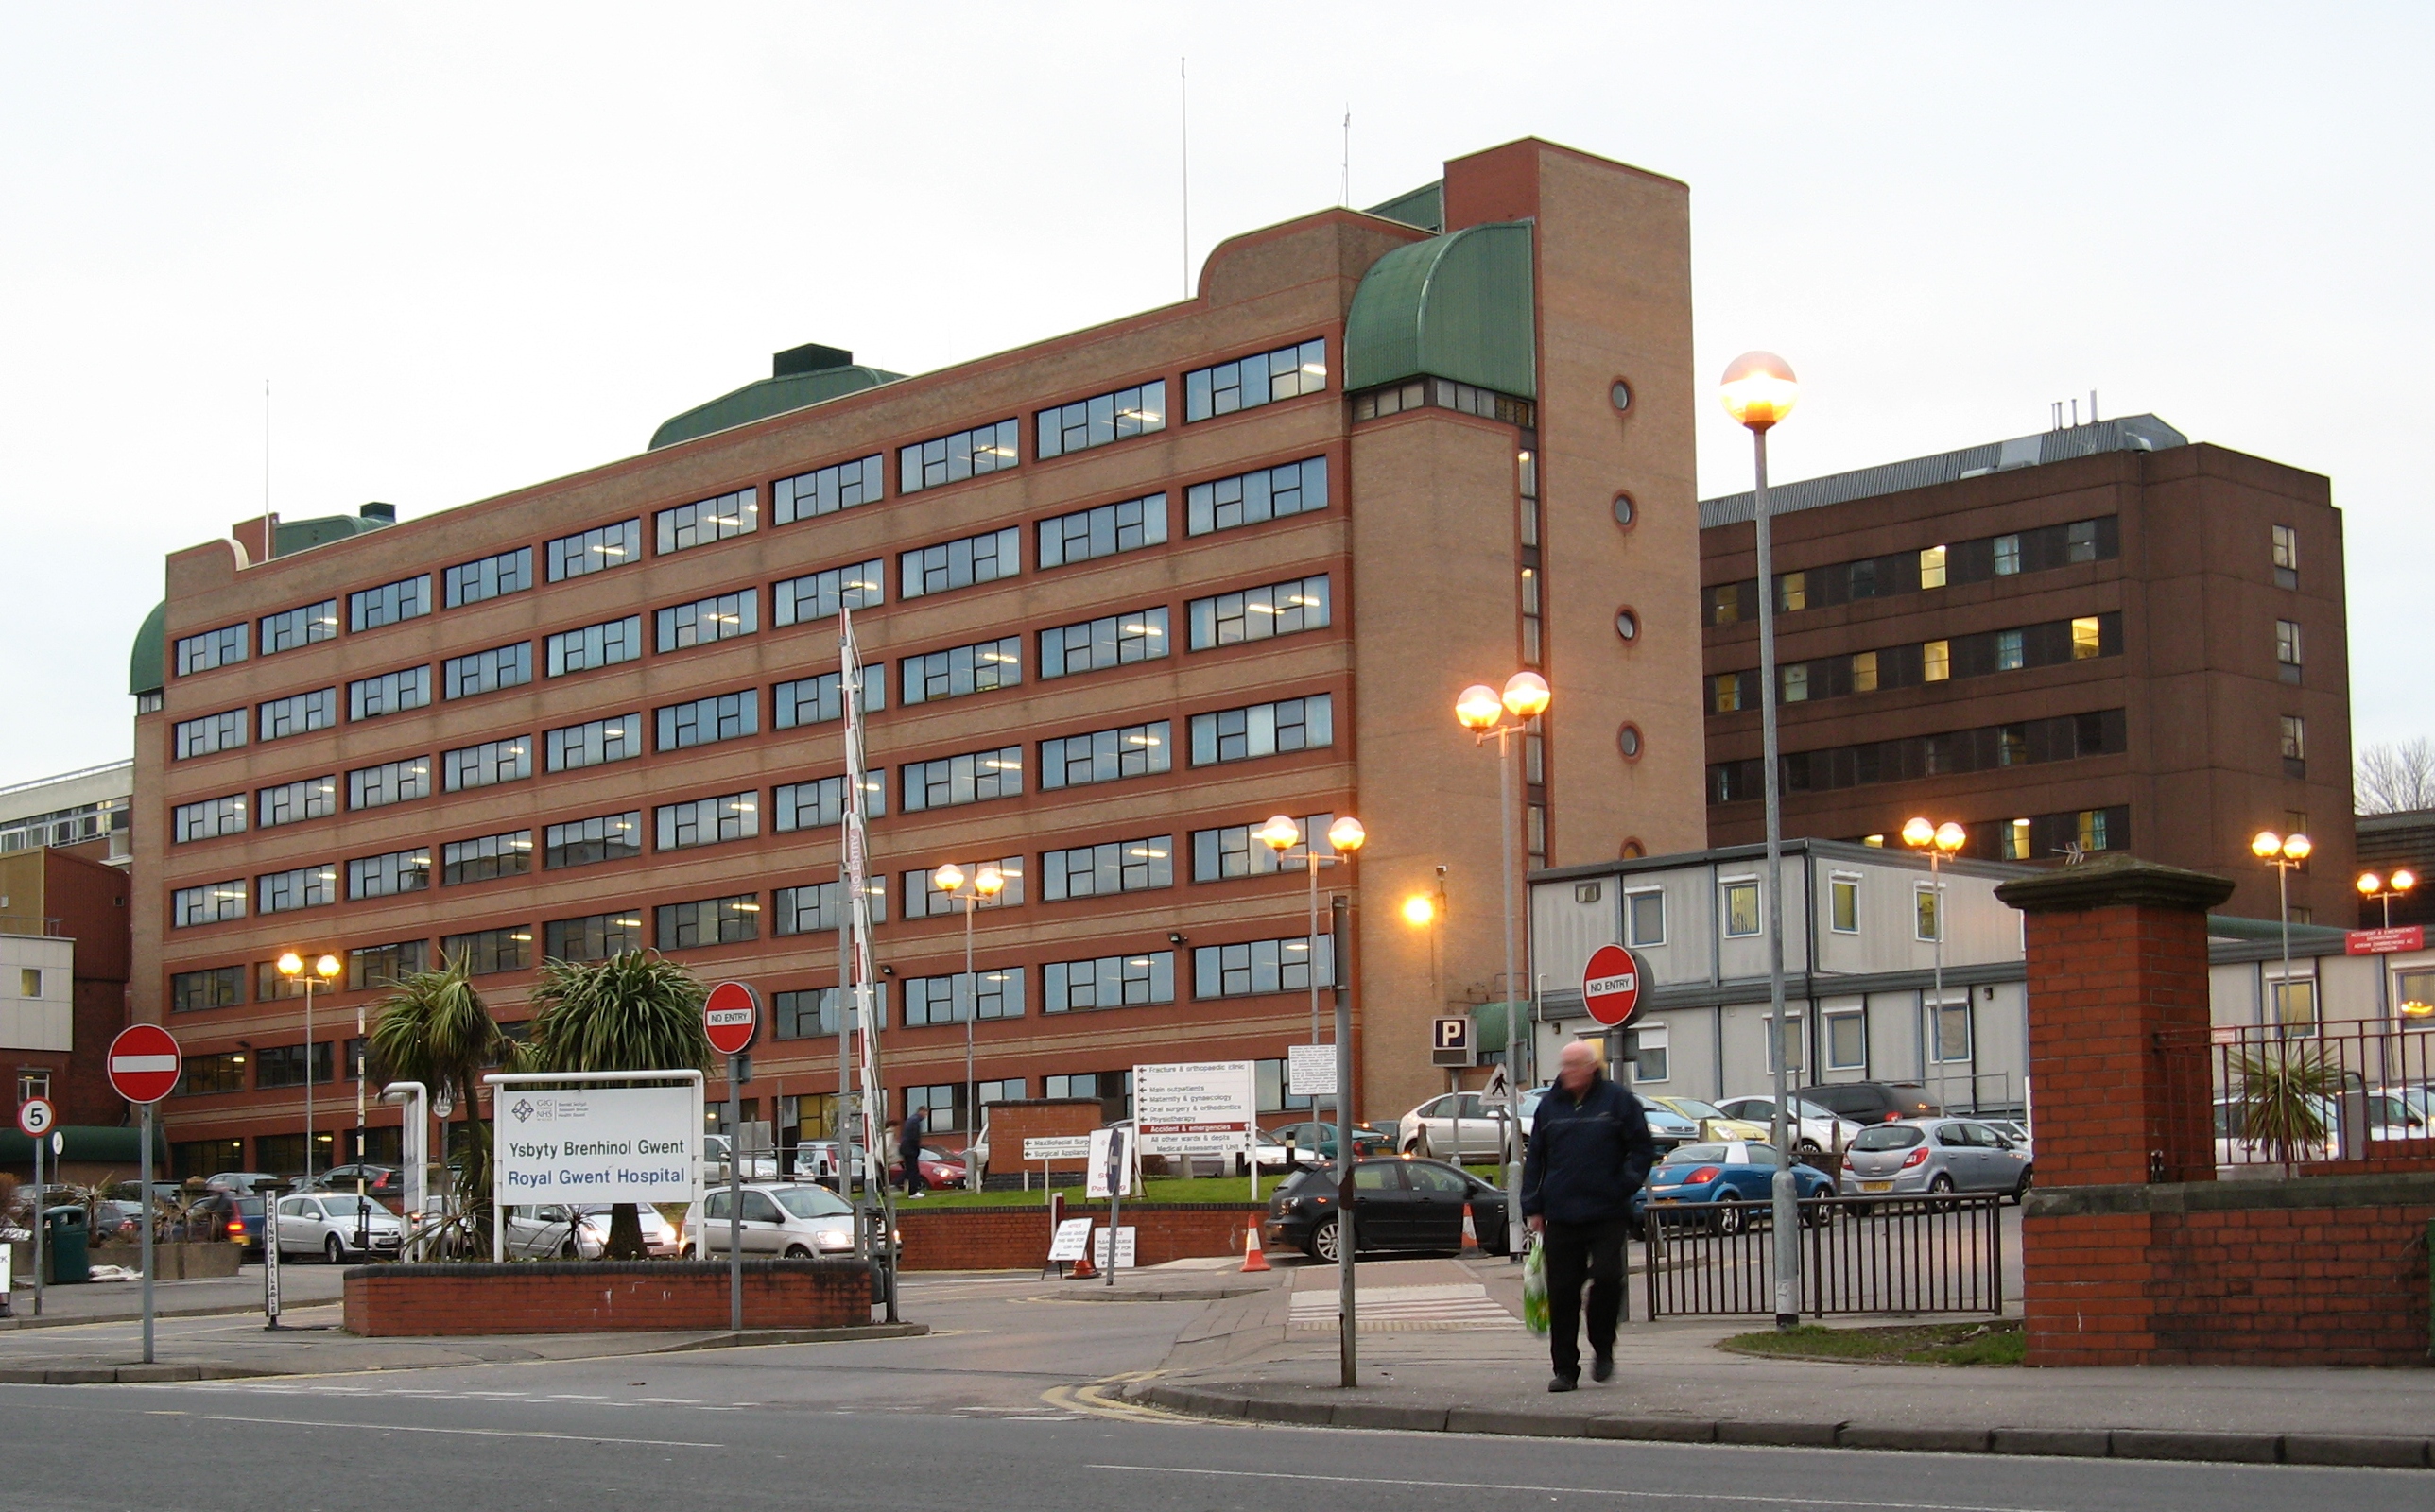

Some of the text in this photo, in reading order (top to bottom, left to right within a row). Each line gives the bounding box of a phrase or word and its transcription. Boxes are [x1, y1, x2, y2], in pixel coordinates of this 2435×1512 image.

[1590, 978, 1630, 992] NO ENTRY
[711, 1012, 748, 1022] NO ENTRY
[1442, 1021, 1461, 1047] P
[1190, 1094, 1232, 1103] gynaecology
[29, 1108, 43, 1126] 5
[509, 1139, 684, 1159] Ysbyty Brenhinol Gwent
[509, 1167, 684, 1188] Royal Gwent Hospital
[268, 1248, 277, 1313] AVAILABLE
